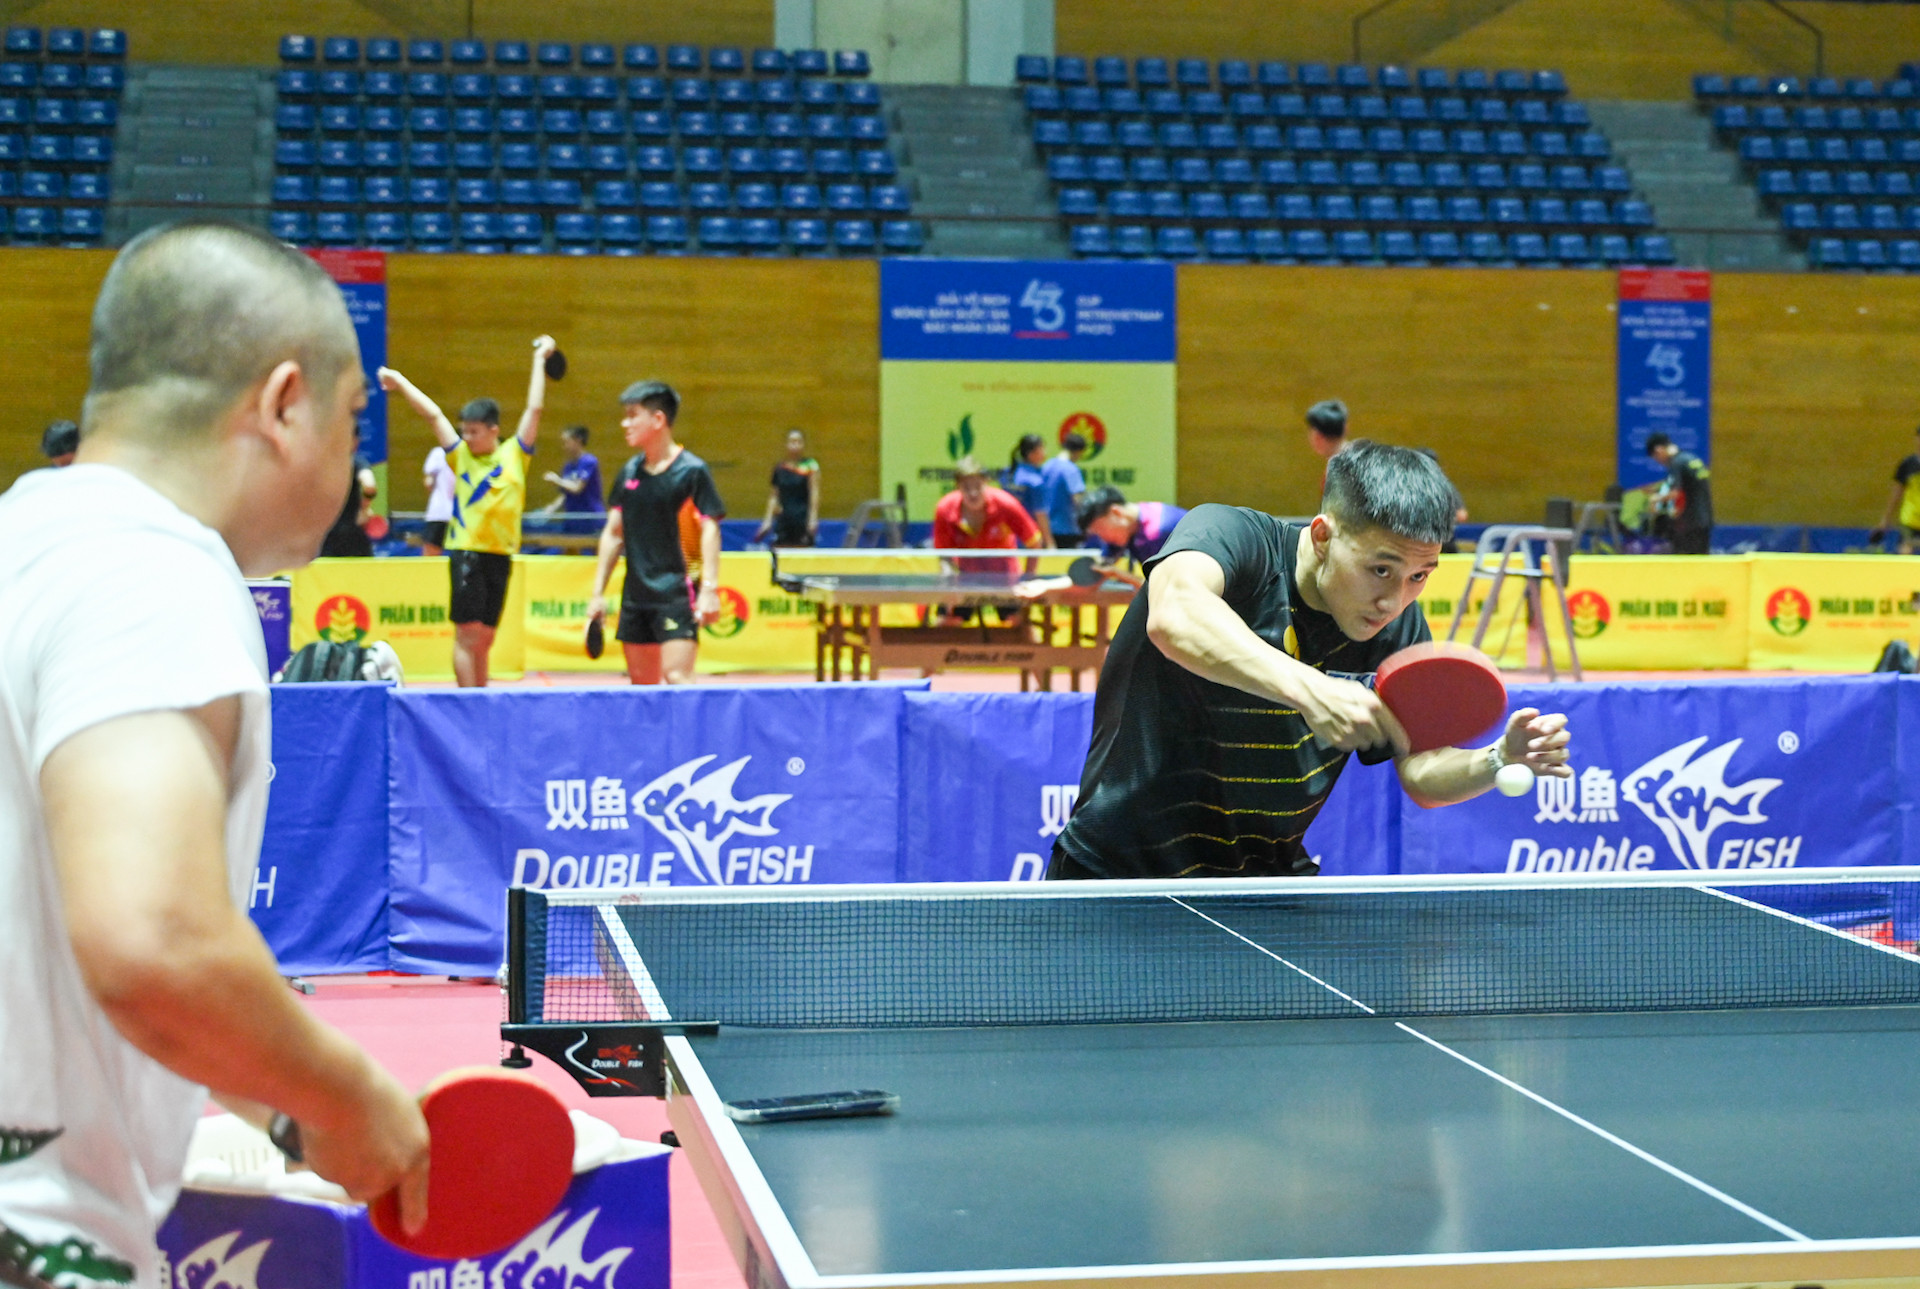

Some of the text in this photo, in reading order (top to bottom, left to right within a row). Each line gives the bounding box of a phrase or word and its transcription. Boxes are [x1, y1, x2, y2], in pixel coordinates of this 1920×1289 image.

[545, 776, 629, 831] 双魚
[512, 845, 815, 888] DOUBLE FISH
[1505, 835, 1803, 873] Double FISH
[591, 1058, 644, 1068] DOUBLE FISH
